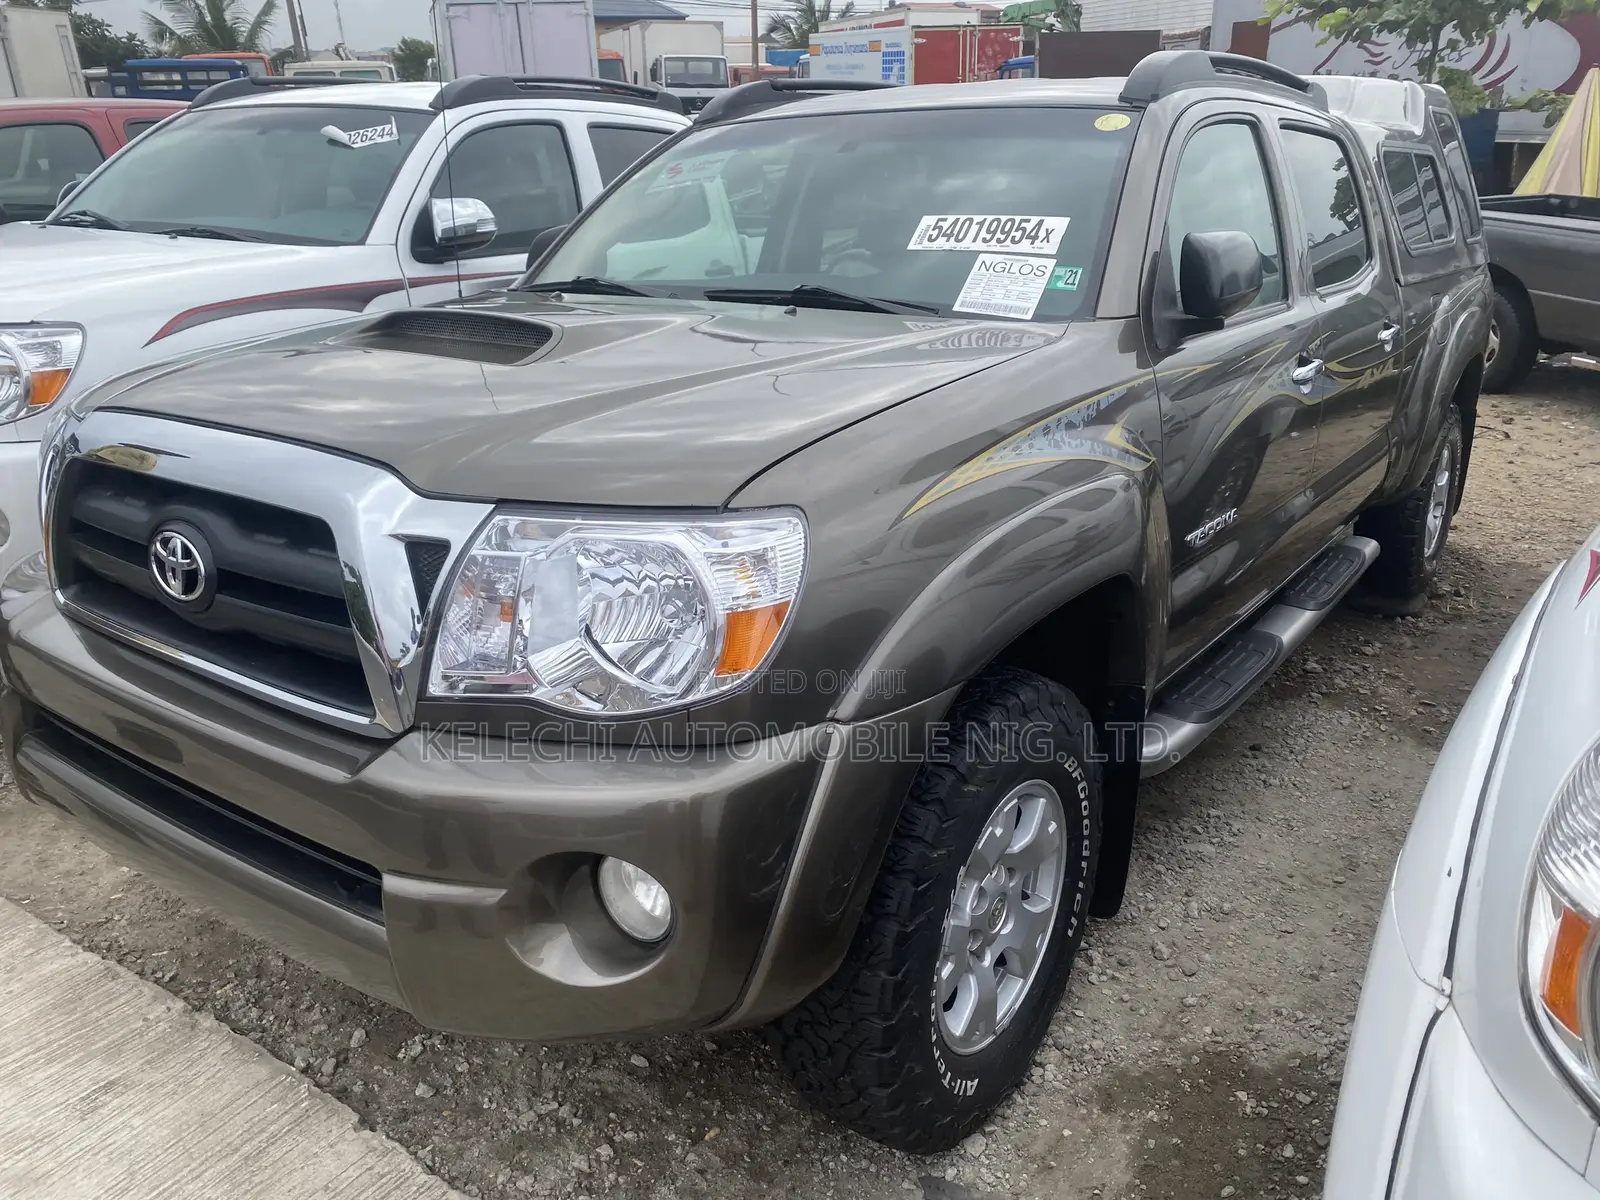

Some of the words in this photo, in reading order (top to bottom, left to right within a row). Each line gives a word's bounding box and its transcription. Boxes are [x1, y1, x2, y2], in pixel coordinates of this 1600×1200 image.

[977, 259, 1048, 278] NGLOS
[1063, 269, 1079, 287] 21
[1053, 756, 1091, 938] BFGoodrich
